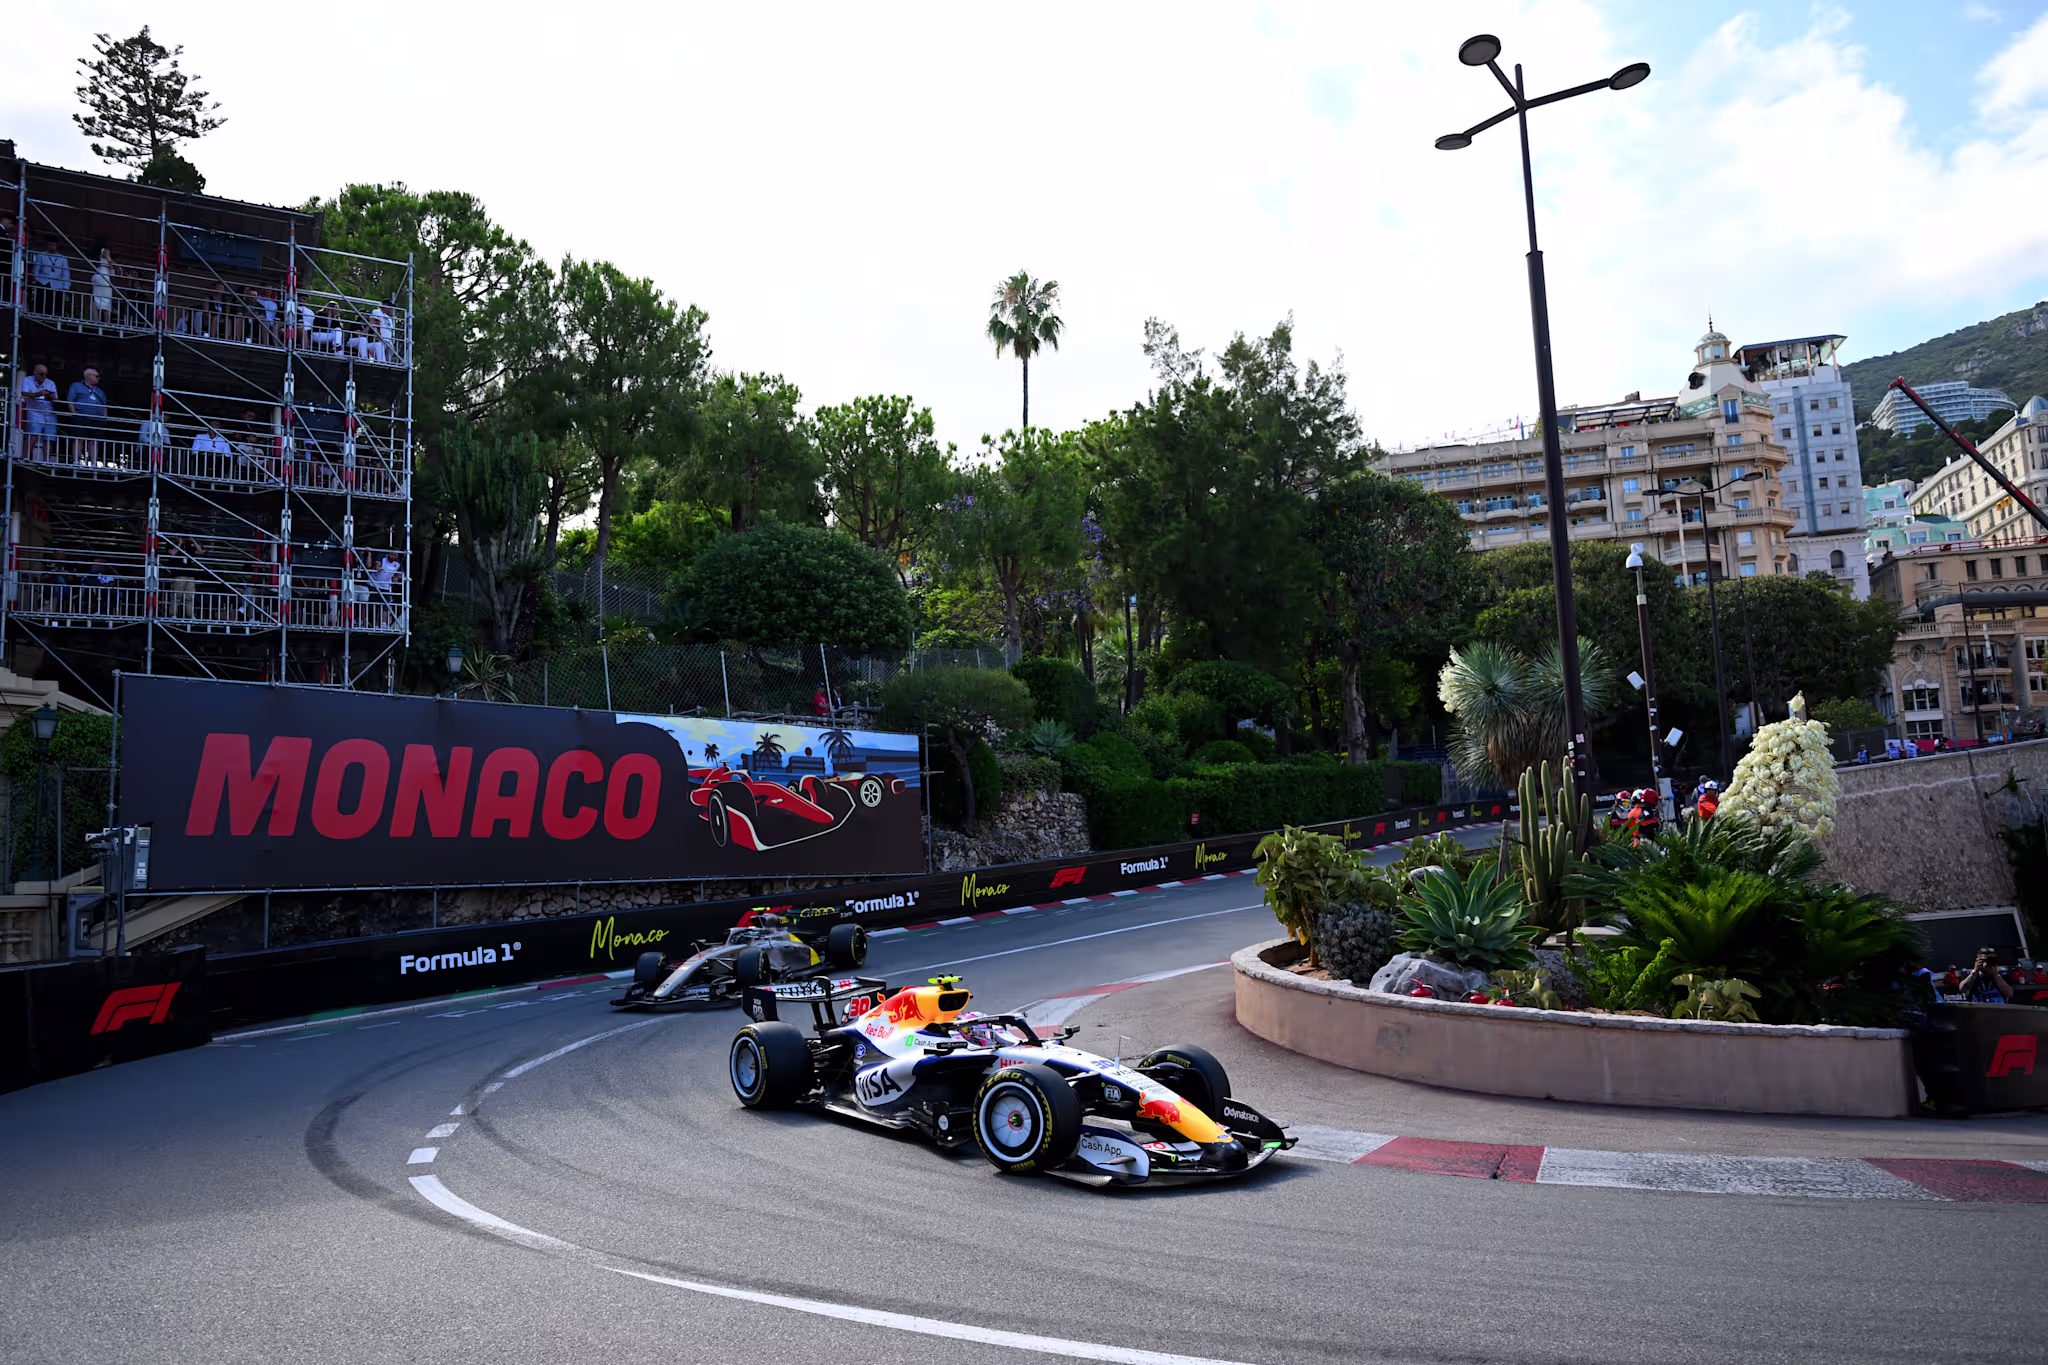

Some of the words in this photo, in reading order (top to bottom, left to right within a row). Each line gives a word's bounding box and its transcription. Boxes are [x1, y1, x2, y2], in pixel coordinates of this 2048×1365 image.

[185, 733, 662, 840] MONACO
[1120, 859, 1160, 875] Formula
[1195, 842, 1228, 872] Monaco
[961, 873, 1010, 908] Monaco
[1049, 866, 1088, 888] F1
[590, 916, 670, 961] Monaco
[400, 946, 497, 975] Formula
[89, 981, 183, 1035] F1
[849, 996, 871, 1018] 30
[865, 1023, 878, 1036] Red
[877, 1026, 894, 1040] Bull
[1986, 1034, 2038, 1078] F1
[858, 1067, 903, 1101] VISA
[1105, 1086, 1120, 1100] FIA
[1229, 1106, 1260, 1124] dynatrace
[1081, 1138, 1103, 1152] Cash
[1104, 1143, 1122, 1157] App
